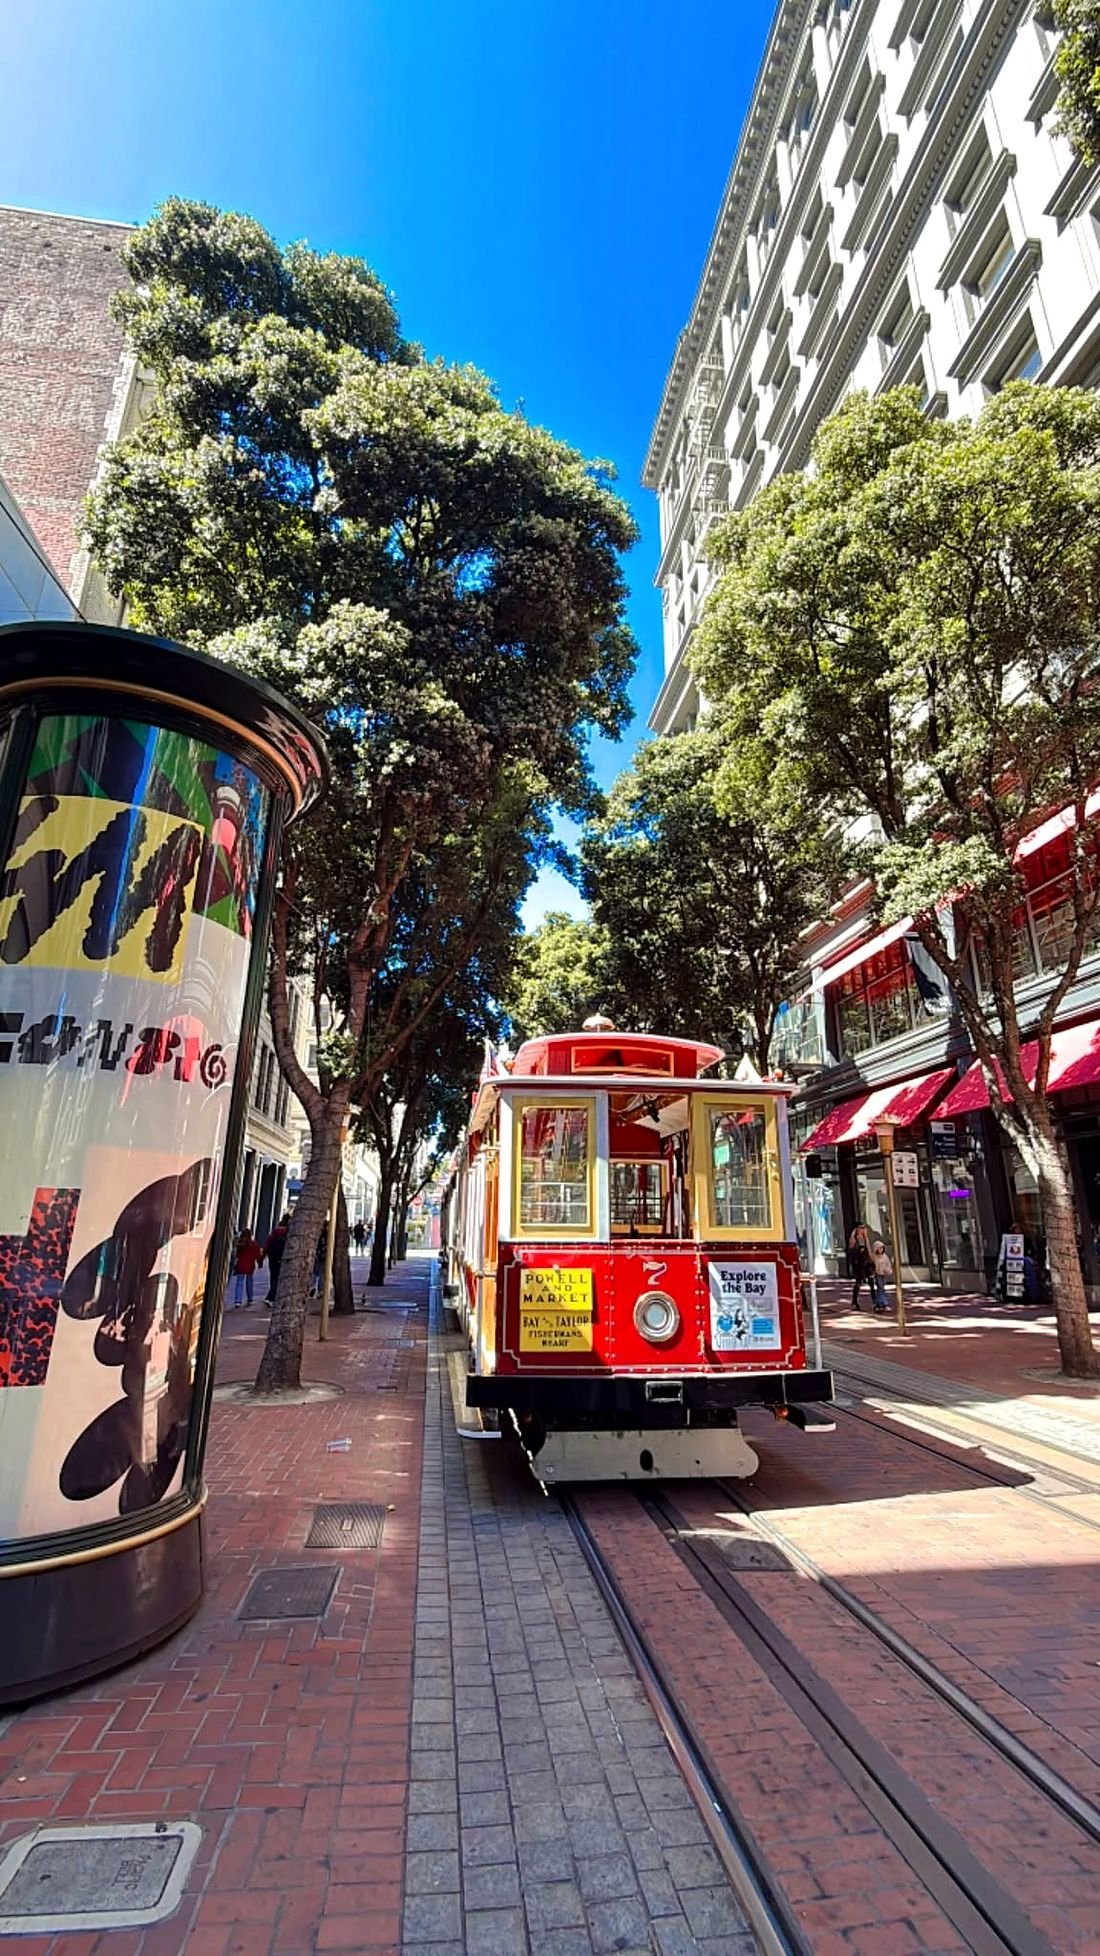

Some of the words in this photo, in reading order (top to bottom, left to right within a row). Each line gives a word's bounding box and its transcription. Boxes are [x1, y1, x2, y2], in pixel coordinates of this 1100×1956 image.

[525, 1273, 588, 1284] POWELL
[642, 1261, 667, 1285] 7
[720, 1269, 767, 1284] Explore
[542, 1284, 572, 1292] AND
[722, 1282, 742, 1294] the
[744, 1282, 767, 1297] Bay
[523, 1293, 589, 1303] MARKET
[522, 1316, 540, 1328] BAY
[555, 1315, 589, 1328] TAYLOR
[528, 1330, 583, 1338] FISHERMANS
[541, 1339, 568, 1347] WHARF
